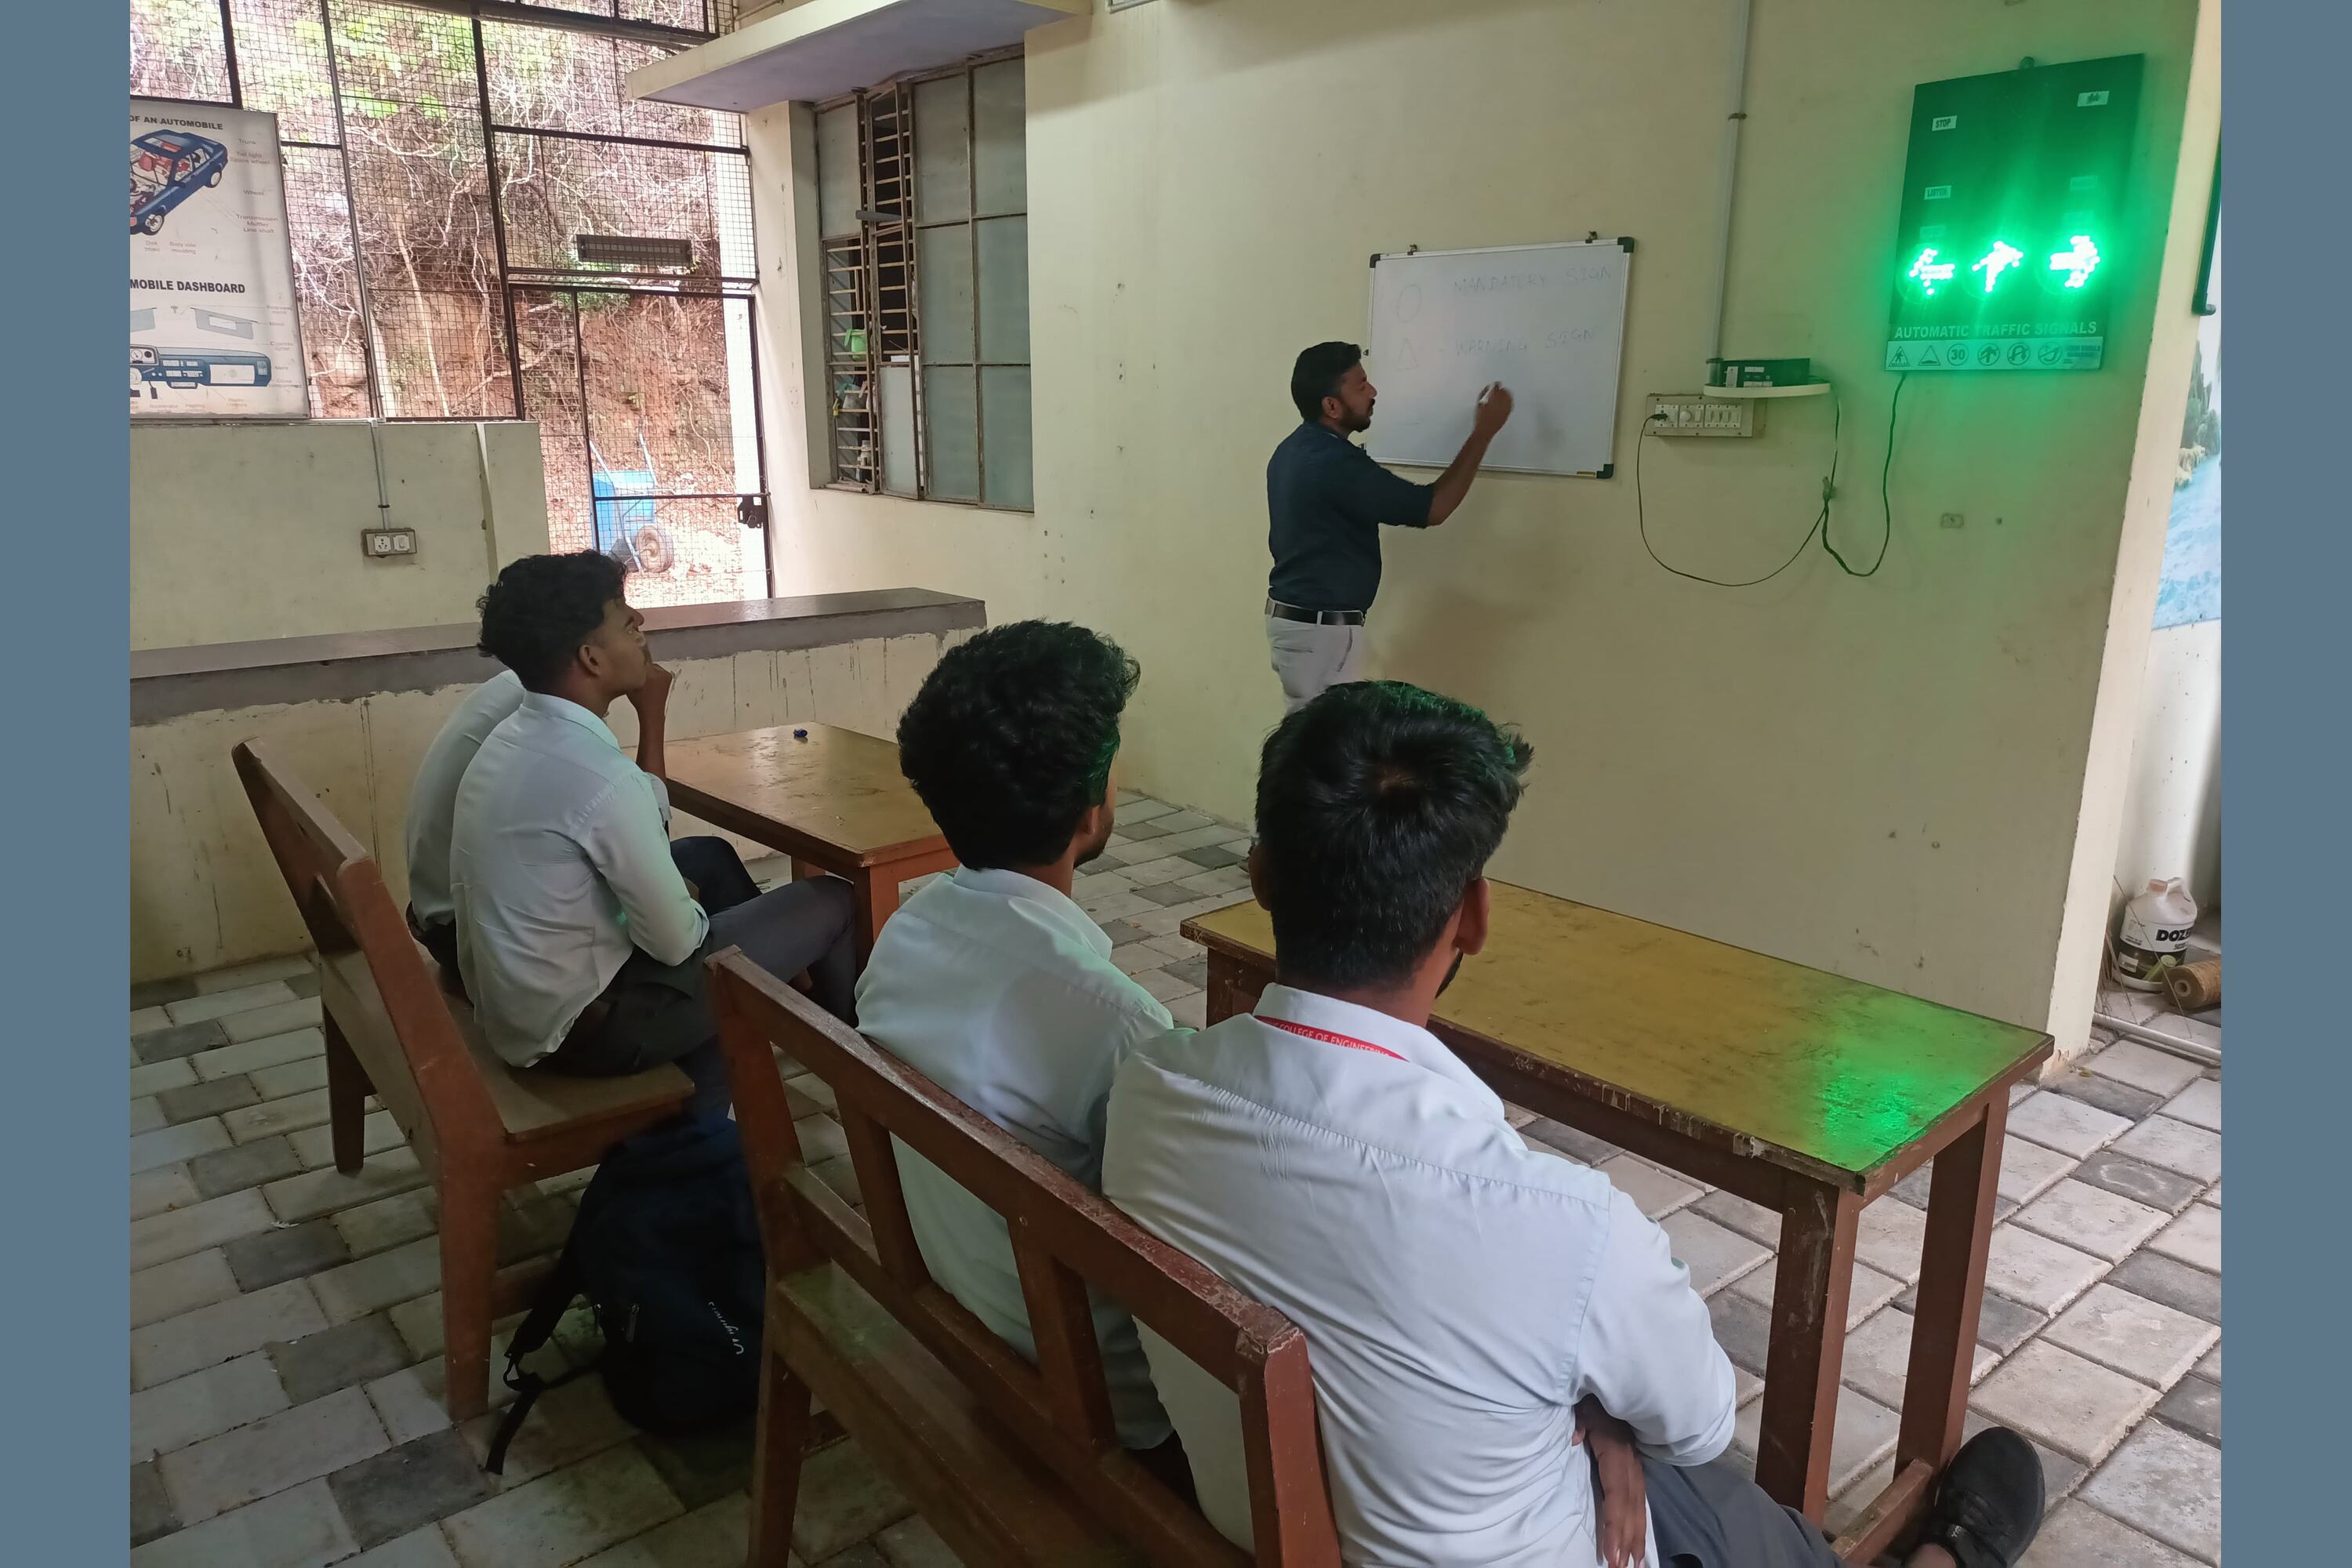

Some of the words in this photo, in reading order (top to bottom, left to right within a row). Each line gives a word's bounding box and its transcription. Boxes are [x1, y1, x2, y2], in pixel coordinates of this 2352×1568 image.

[160, 118, 223, 130] AUTOMOBILE
[1936, 118, 1951, 129] STOP
[130, 279, 174, 291] MOBILE
[176, 281, 245, 293] DASHBOARD
[1894, 325, 1969, 339] AUTOMATIC
[1975, 323, 2031, 337] TRAFFIC
[2034, 321, 2097, 336] SIGNALS
[1950, 348, 1965, 361] 30
[1279, 1023, 1314, 1038] COLLEGE
[1316, 1032, 1330, 1042] OF
